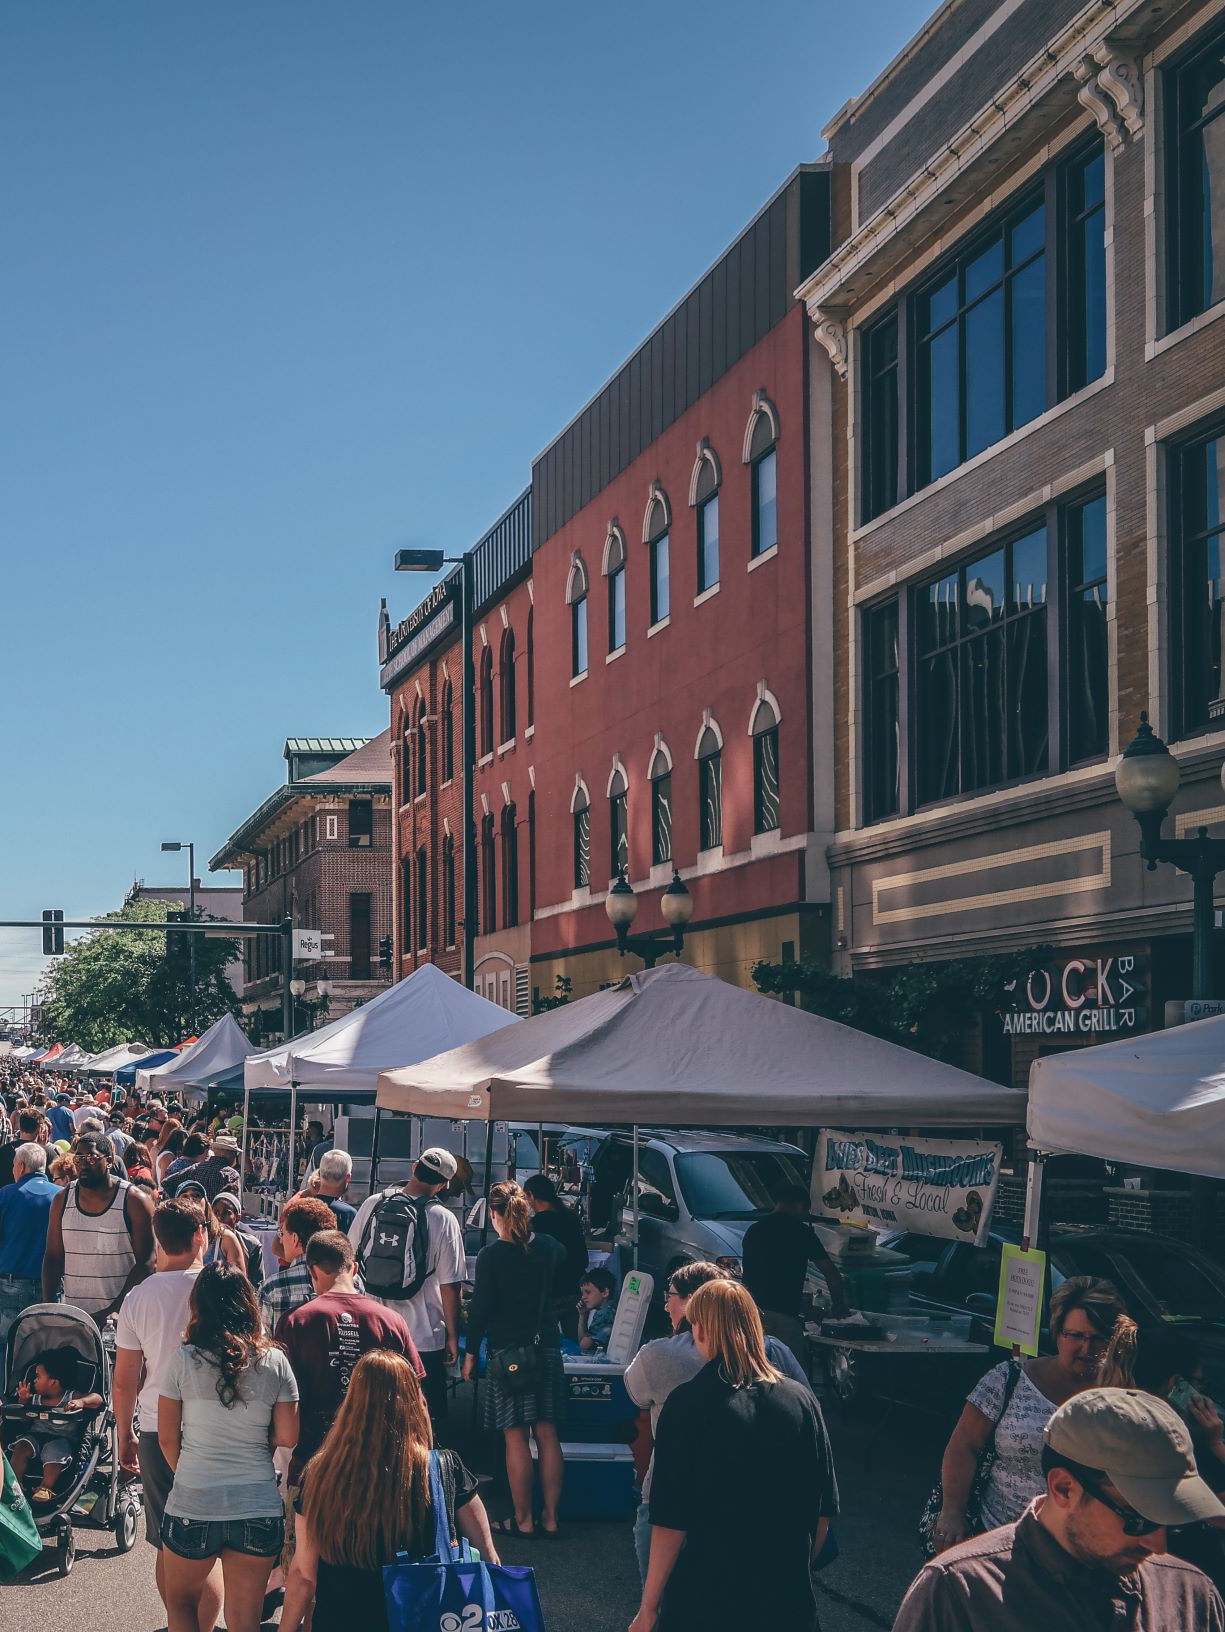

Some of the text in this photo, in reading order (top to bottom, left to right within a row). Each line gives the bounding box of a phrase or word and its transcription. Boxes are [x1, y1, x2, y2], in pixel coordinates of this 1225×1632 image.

[300, 939, 319, 953] Regus
[1003, 957, 1116, 1010] OCK
[1118, 956, 1135, 1027] BAR
[1003, 1008, 1117, 1034] AMERICAN GRILL
[854, 1172, 889, 1203] Fresh
[905, 1180, 950, 1214] Local
[461, 1603, 483, 1632] 2
[504, 1611, 519, 1629] 28
